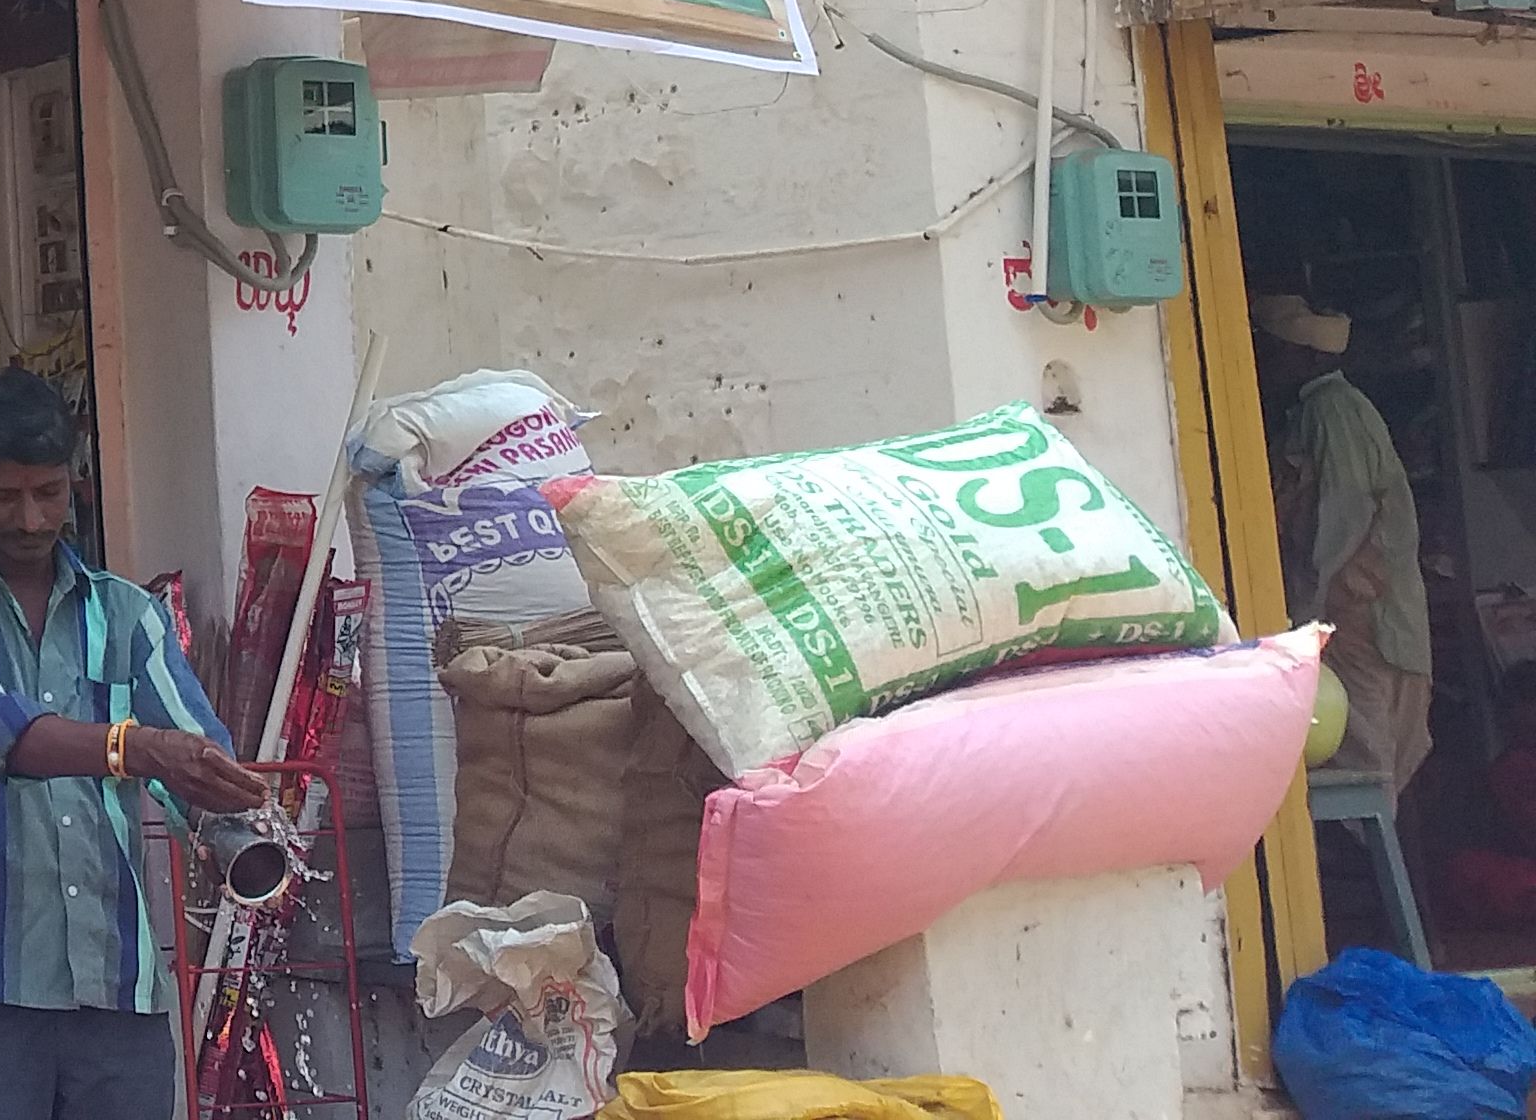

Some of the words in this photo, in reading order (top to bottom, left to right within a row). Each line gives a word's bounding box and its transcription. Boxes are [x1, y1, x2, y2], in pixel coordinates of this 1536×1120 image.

[499, 426, 582, 465] PASAN
[880, 416, 1161, 626] DS-1
[897, 474, 999, 579] Gold
[825, 499, 928, 650] TRADERS
[785, 602, 855, 693] DS-1
